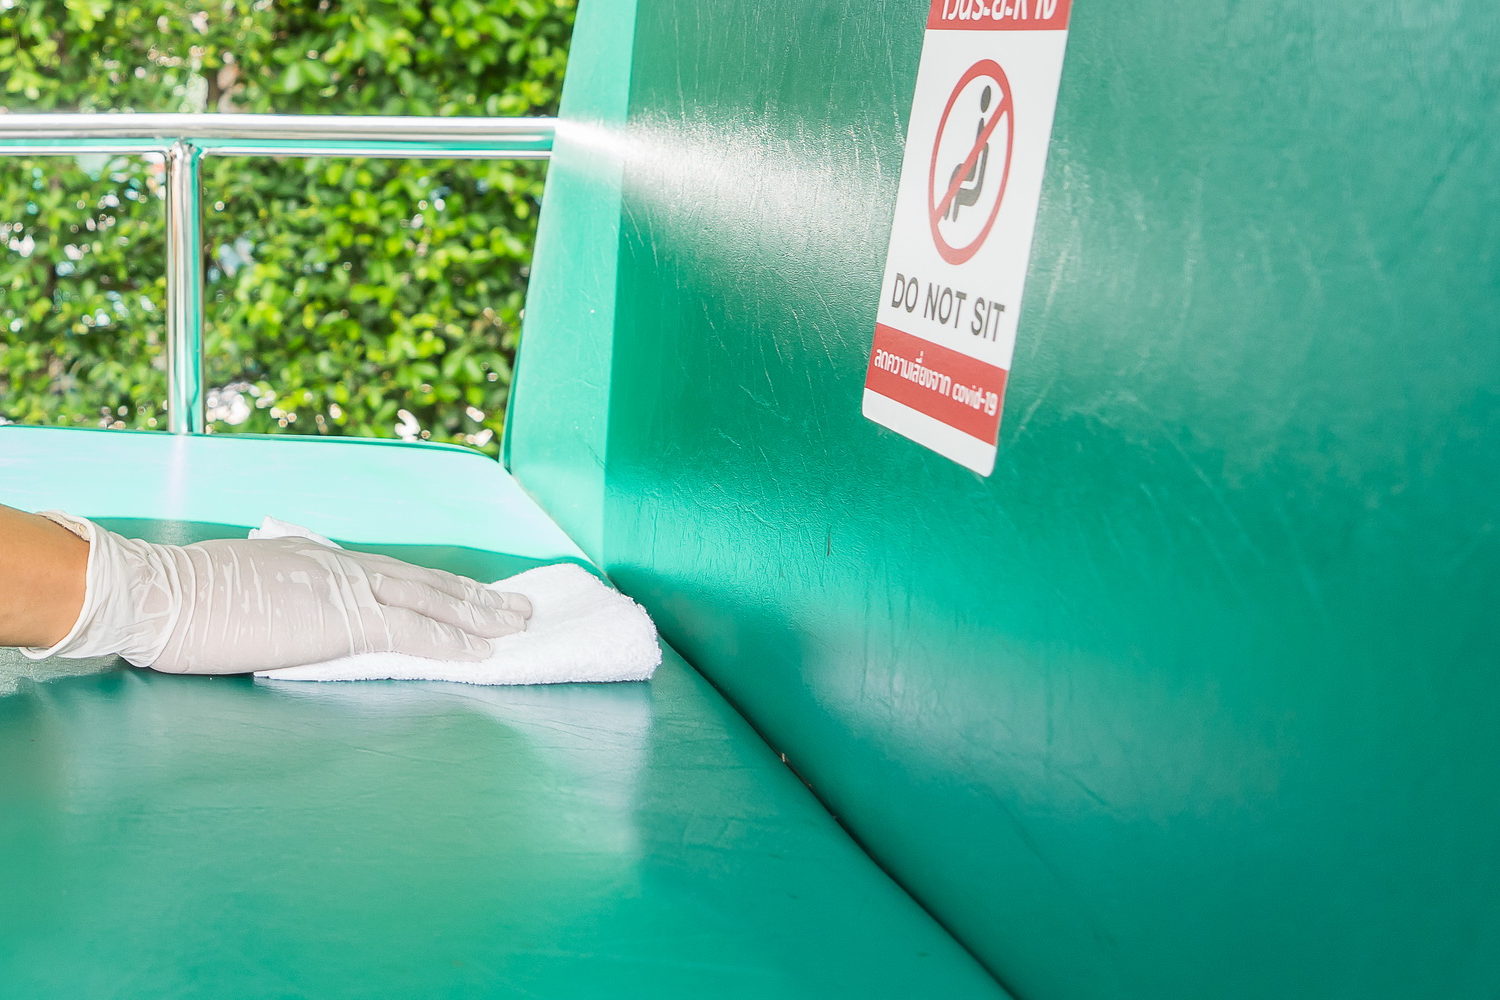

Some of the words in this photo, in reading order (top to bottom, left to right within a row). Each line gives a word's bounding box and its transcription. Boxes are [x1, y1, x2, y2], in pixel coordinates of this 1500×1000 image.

[891, 272, 919, 313] DO
[923, 282, 967, 329] NOT
[970, 296, 1006, 342] SIT
[874, 348, 952, 397] ลดความเสี่ยงจาก
[952, 384, 999, 417] covid-19
